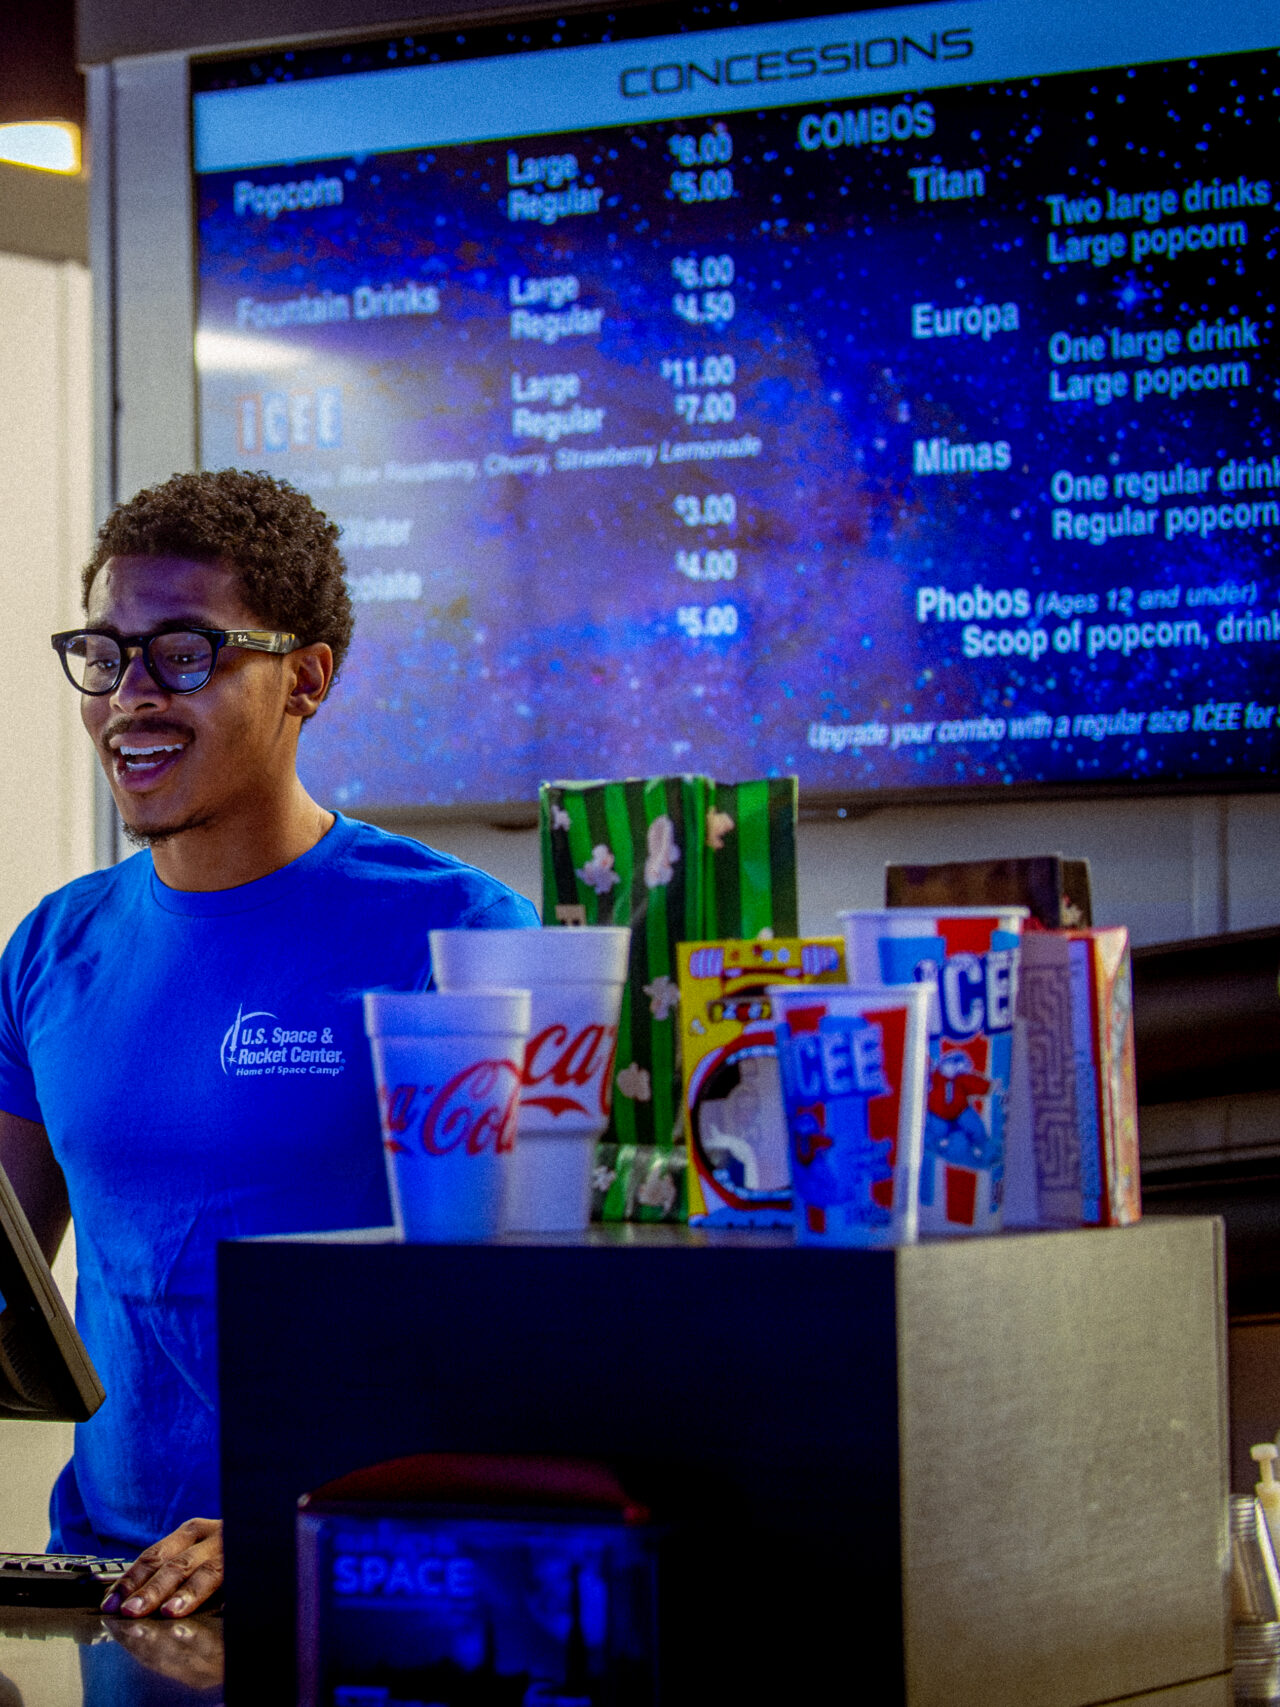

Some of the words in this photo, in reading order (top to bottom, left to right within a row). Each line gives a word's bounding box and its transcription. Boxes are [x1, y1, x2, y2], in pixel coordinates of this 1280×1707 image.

[620, 28, 975, 98] CONCESSIONS
[798, 101, 936, 150] COMBOS
[507, 153, 579, 188] Large
[908, 165, 986, 202] Titan
[233, 177, 344, 220] Popcorn
[508, 182, 604, 225] Regular
[671, 169, 733, 203] $5.00
[1045, 194, 1104, 225] Two
[1105, 186, 1179, 224] large
[1183, 176, 1272, 212] drinks
[1047, 232, 1128, 267] Large
[1131, 220, 1249, 263] popcorn
[237, 291, 350, 330] Fountain
[352, 278, 440, 320] Drinks
[510, 303, 606, 345] Regular
[672, 290, 736, 325] $4.50
[509, 275, 580, 309] Large
[912, 302, 1019, 342] Europa
[1049, 331, 1107, 364] One
[1111, 326, 1182, 363] large
[1186, 315, 1260, 353] drink
[511, 372, 580, 406] Large
[660, 355, 736, 389] $11.00
[1049, 369, 1129, 406] Large
[1133, 361, 1251, 402] popcorn
[512, 404, 608, 442] Regular
[674, 392, 737, 424] $7.00
[659, 432, 763, 463] Lemonade
[914, 437, 1012, 476] Mimas
[1051, 470, 1108, 503] One
[1113, 462, 1214, 504] regular
[673, 493, 737, 527] $3.00
[1051, 504, 1160, 546] Regular
[1164, 500, 1280, 541] popcorn
[675, 548, 738, 582] $4.00
[677, 604, 738, 637] $5.00
[917, 583, 1031, 623] Phobos
[1034, 591, 1099, 619] (Ages
[1138, 583, 1182, 610] and
[1186, 580, 1257, 607] under)
[962, 624, 1049, 662] Scoop
[1052, 618, 1082, 654] of
[1086, 618, 1209, 660] popcorn,
[808, 720, 889, 753] Upgrade
[890, 720, 936, 750] your
[937, 715, 1007, 744] combo
[1007, 710, 1052, 739] with
[1054, 715, 1070, 738] a
[1072, 708, 1147, 742] regular
[1147, 706, 1191, 734] size
[1192, 702, 1242, 732] ICEE
[1243, 702, 1275, 729] for
[238, 1047, 287, 1065] Rocket
[241, 1028, 268, 1045] U.S.
[272, 1027, 317, 1046] Space
[320, 1027, 333, 1044] &
[236, 1067, 262, 1076] Home
[265, 1065, 275, 1074] of
[277, 1065, 307, 1075] Space
[334, 1556, 474, 1596] SPACE
